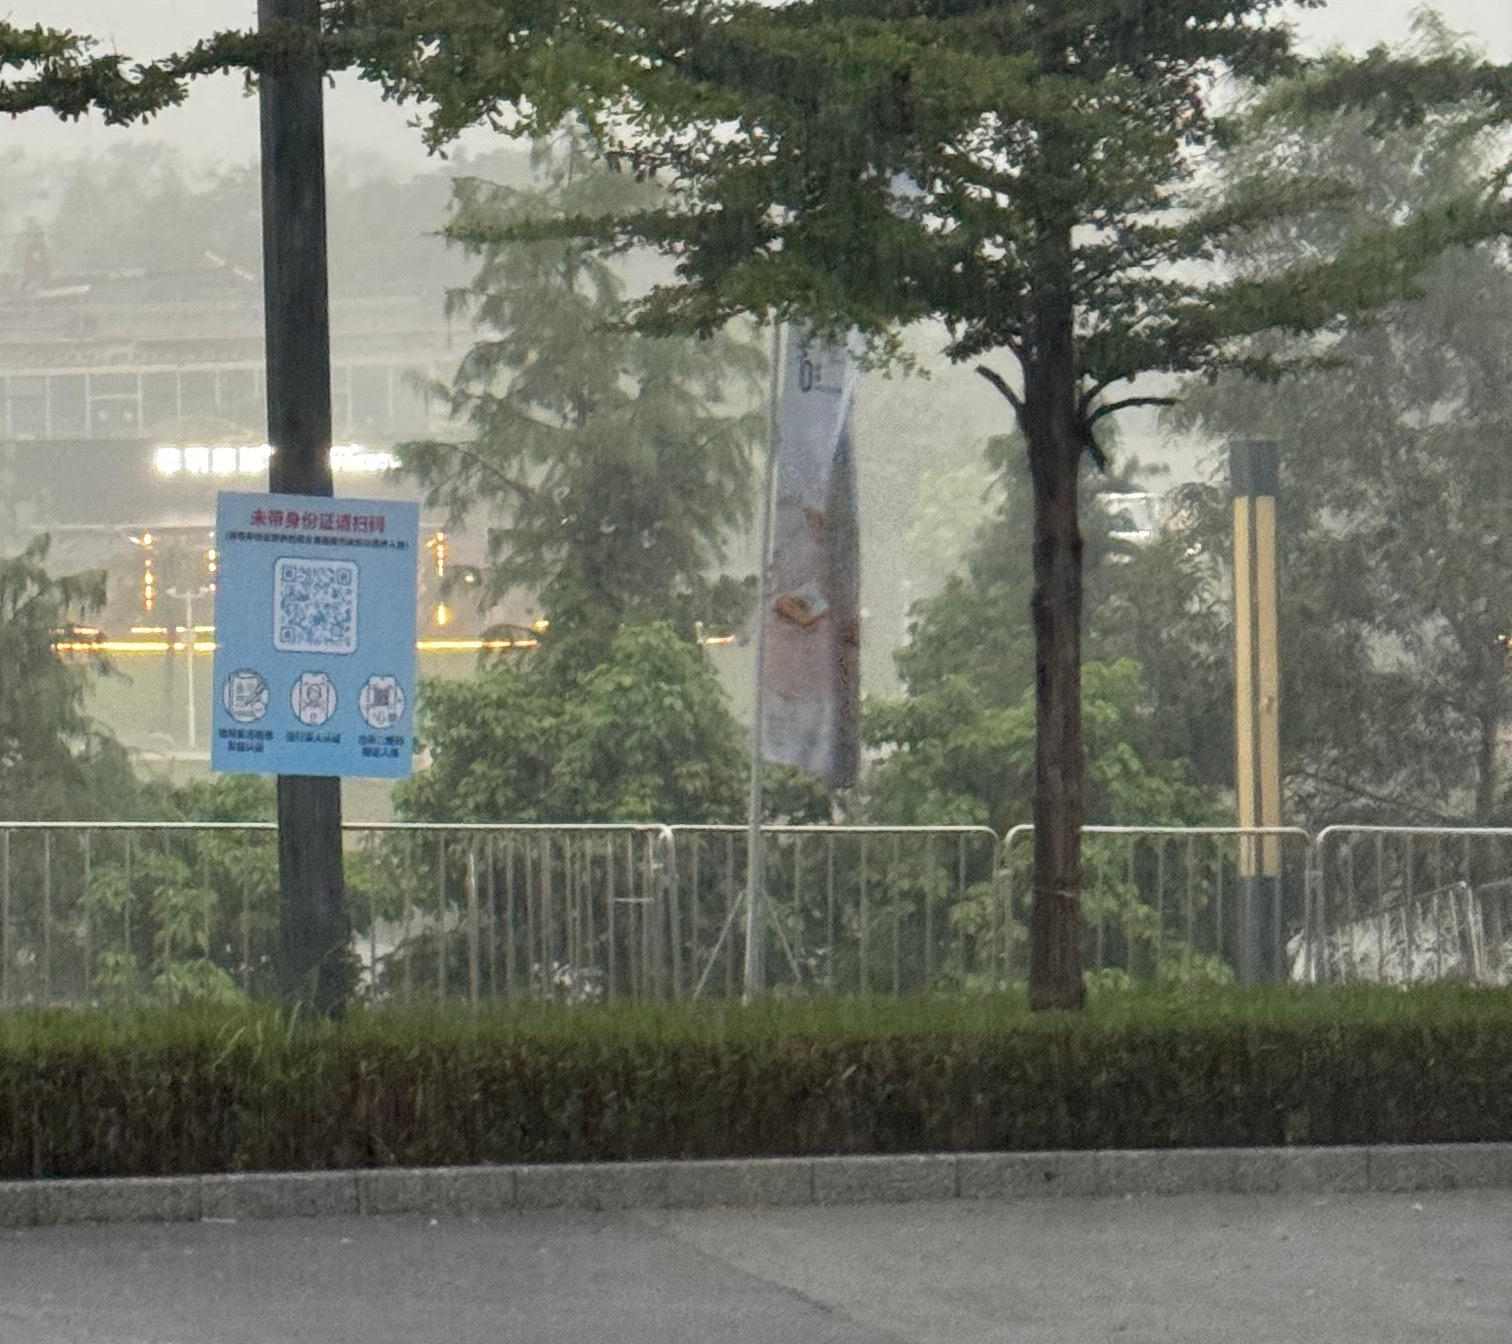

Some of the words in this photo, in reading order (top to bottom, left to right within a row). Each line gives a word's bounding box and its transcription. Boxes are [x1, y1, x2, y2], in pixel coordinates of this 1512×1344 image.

[250, 509, 386, 534] 未带身份证请扫码
